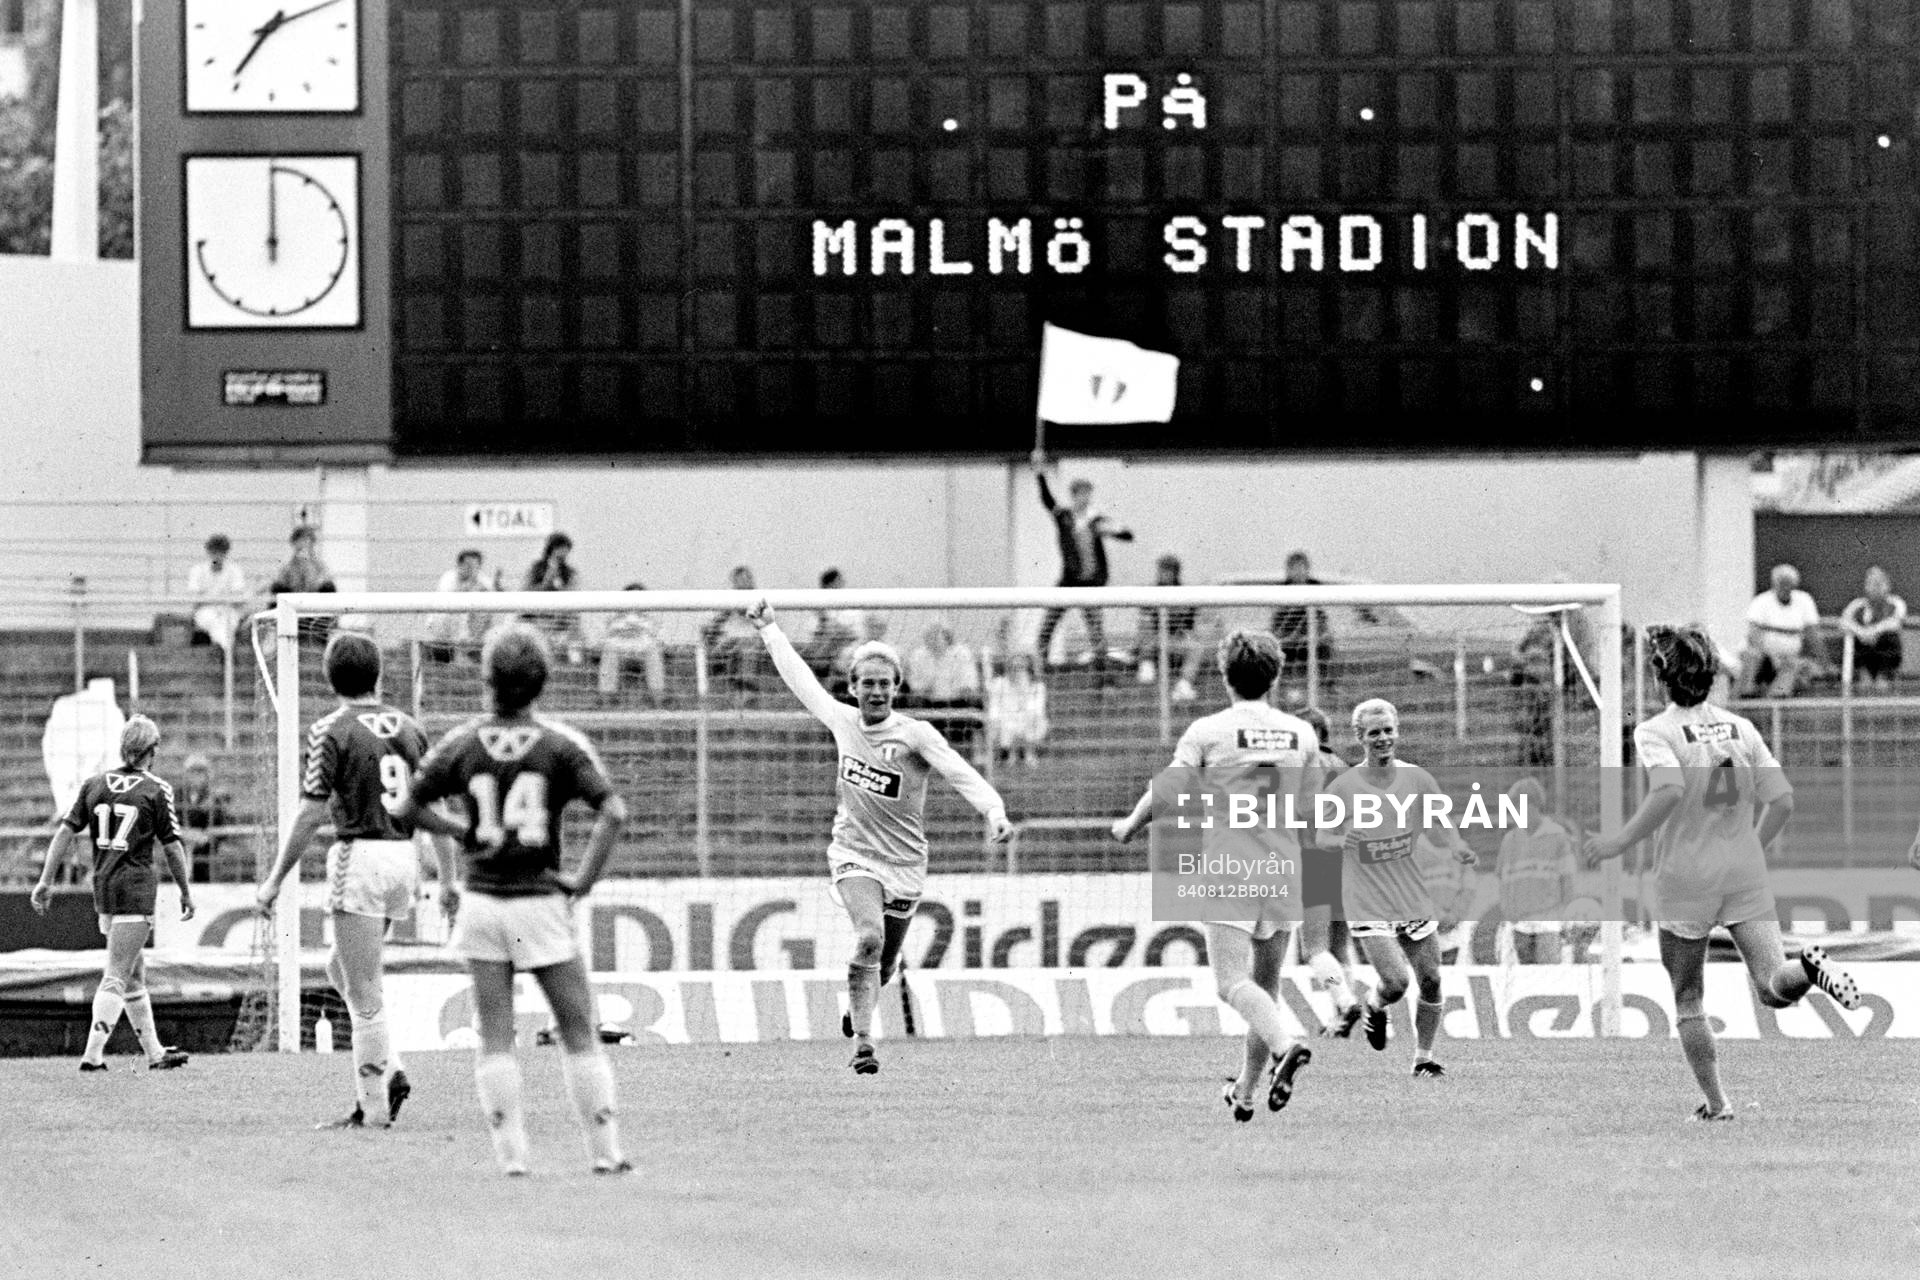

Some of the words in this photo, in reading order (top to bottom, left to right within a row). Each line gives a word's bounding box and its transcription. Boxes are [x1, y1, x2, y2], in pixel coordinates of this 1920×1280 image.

[1163, 213, 1559, 273] STADION
[379, 754, 411, 818] 9
[469, 772, 549, 846] 14
[1703, 757, 1739, 808] 4
[94, 803, 139, 851] 17
